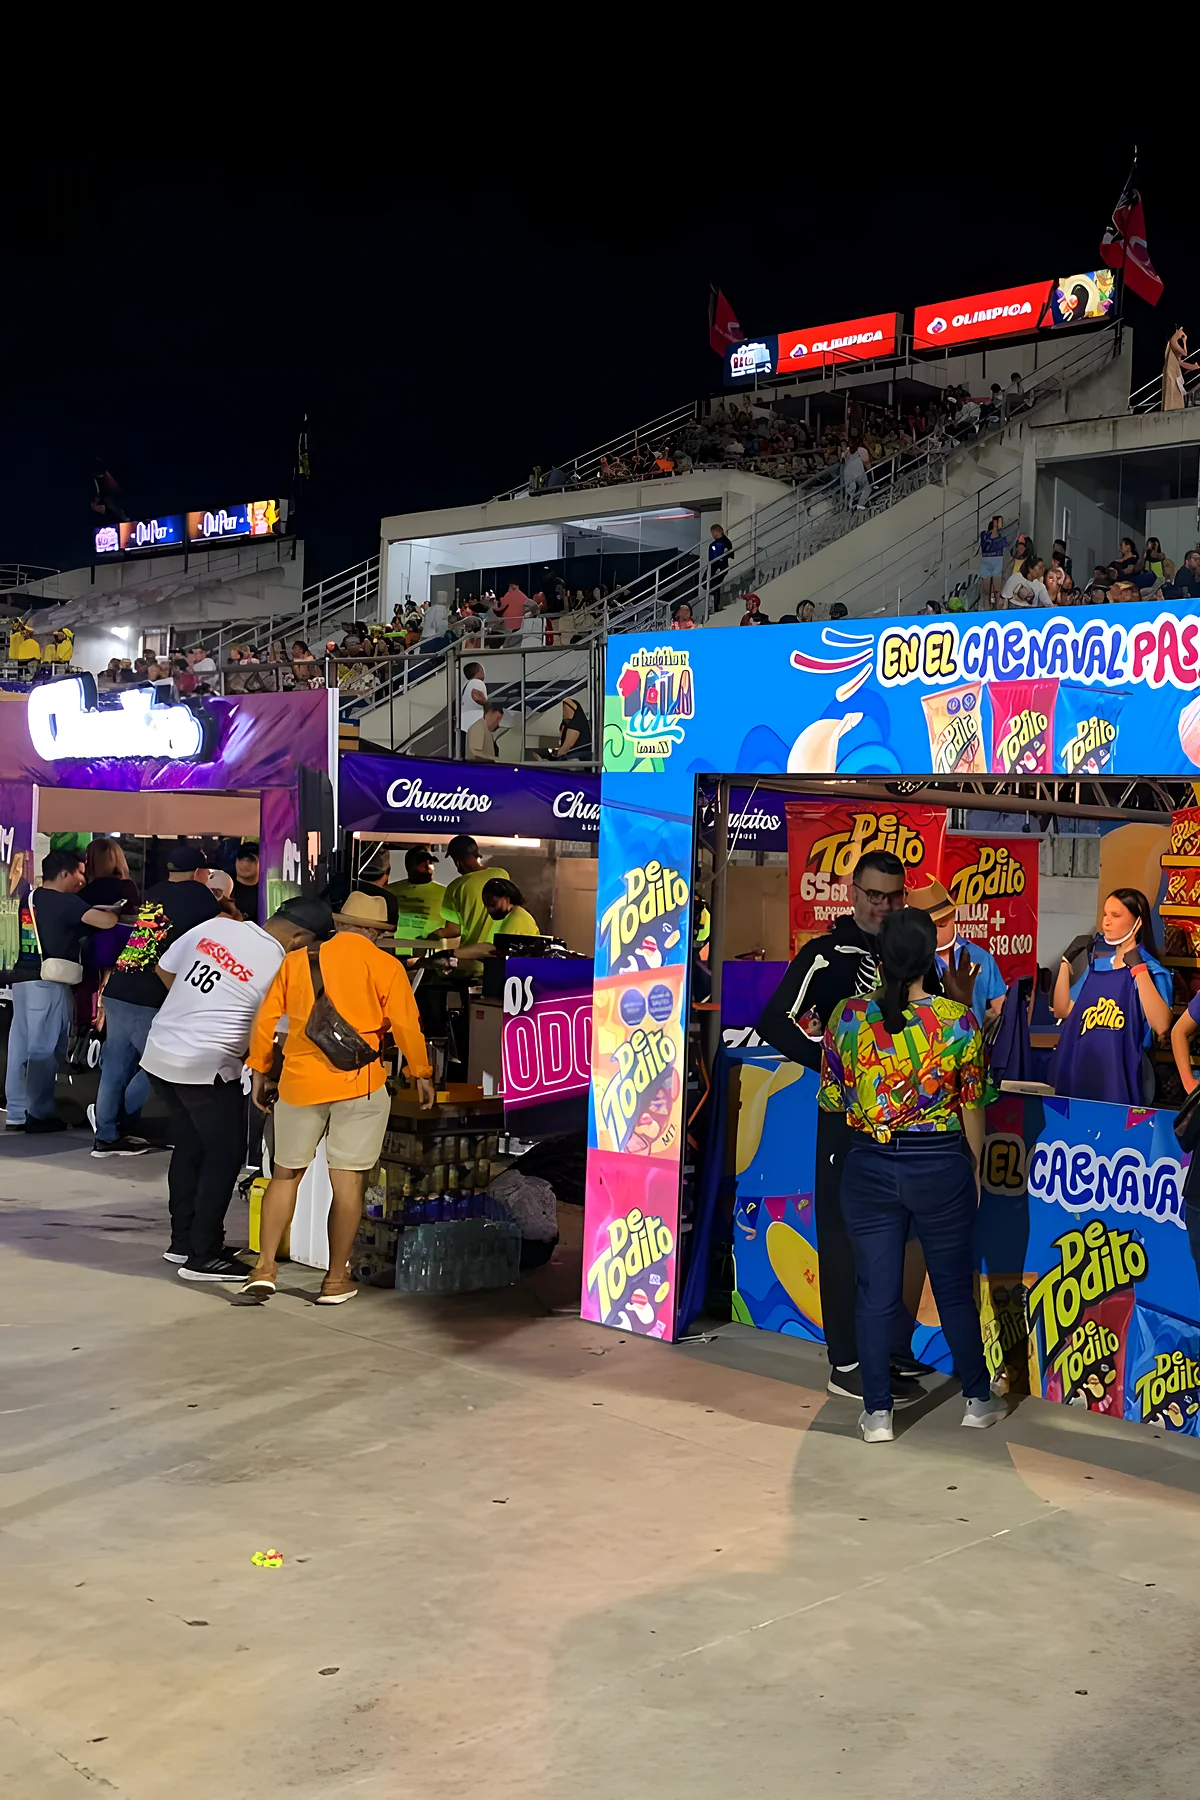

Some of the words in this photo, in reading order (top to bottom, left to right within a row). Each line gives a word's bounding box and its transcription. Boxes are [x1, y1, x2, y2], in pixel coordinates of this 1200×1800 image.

[951, 301, 1032, 328] OLIMPICA
[883, 634, 920, 678] EN
[925, 630, 957, 677] EL
[962, 616, 1128, 681] CARNAVAL
[386, 778, 492, 813] Chuzitos
[809, 826, 924, 877] Todito
[852, 813, 898, 840] De
[626, 859, 661, 903] De
[951, 857, 1025, 905] Todito
[978, 846, 1009, 872] De
[601, 867, 689, 966] Todito
[184, 960, 221, 994] 136
[613, 1029, 646, 1080] De
[601, 1031, 677, 1150] Todito
[1029, 1145, 1188, 1222] CARNAVA
[608, 1207, 643, 1256] De
[1054, 1220, 1105, 1277] De
[588, 1216, 674, 1323] Todito
[1029, 1230, 1147, 1354] Todito
[1072, 1320, 1096, 1351] De
[1053, 1326, 1120, 1397] Todito
[1154, 1350, 1184, 1376] De
